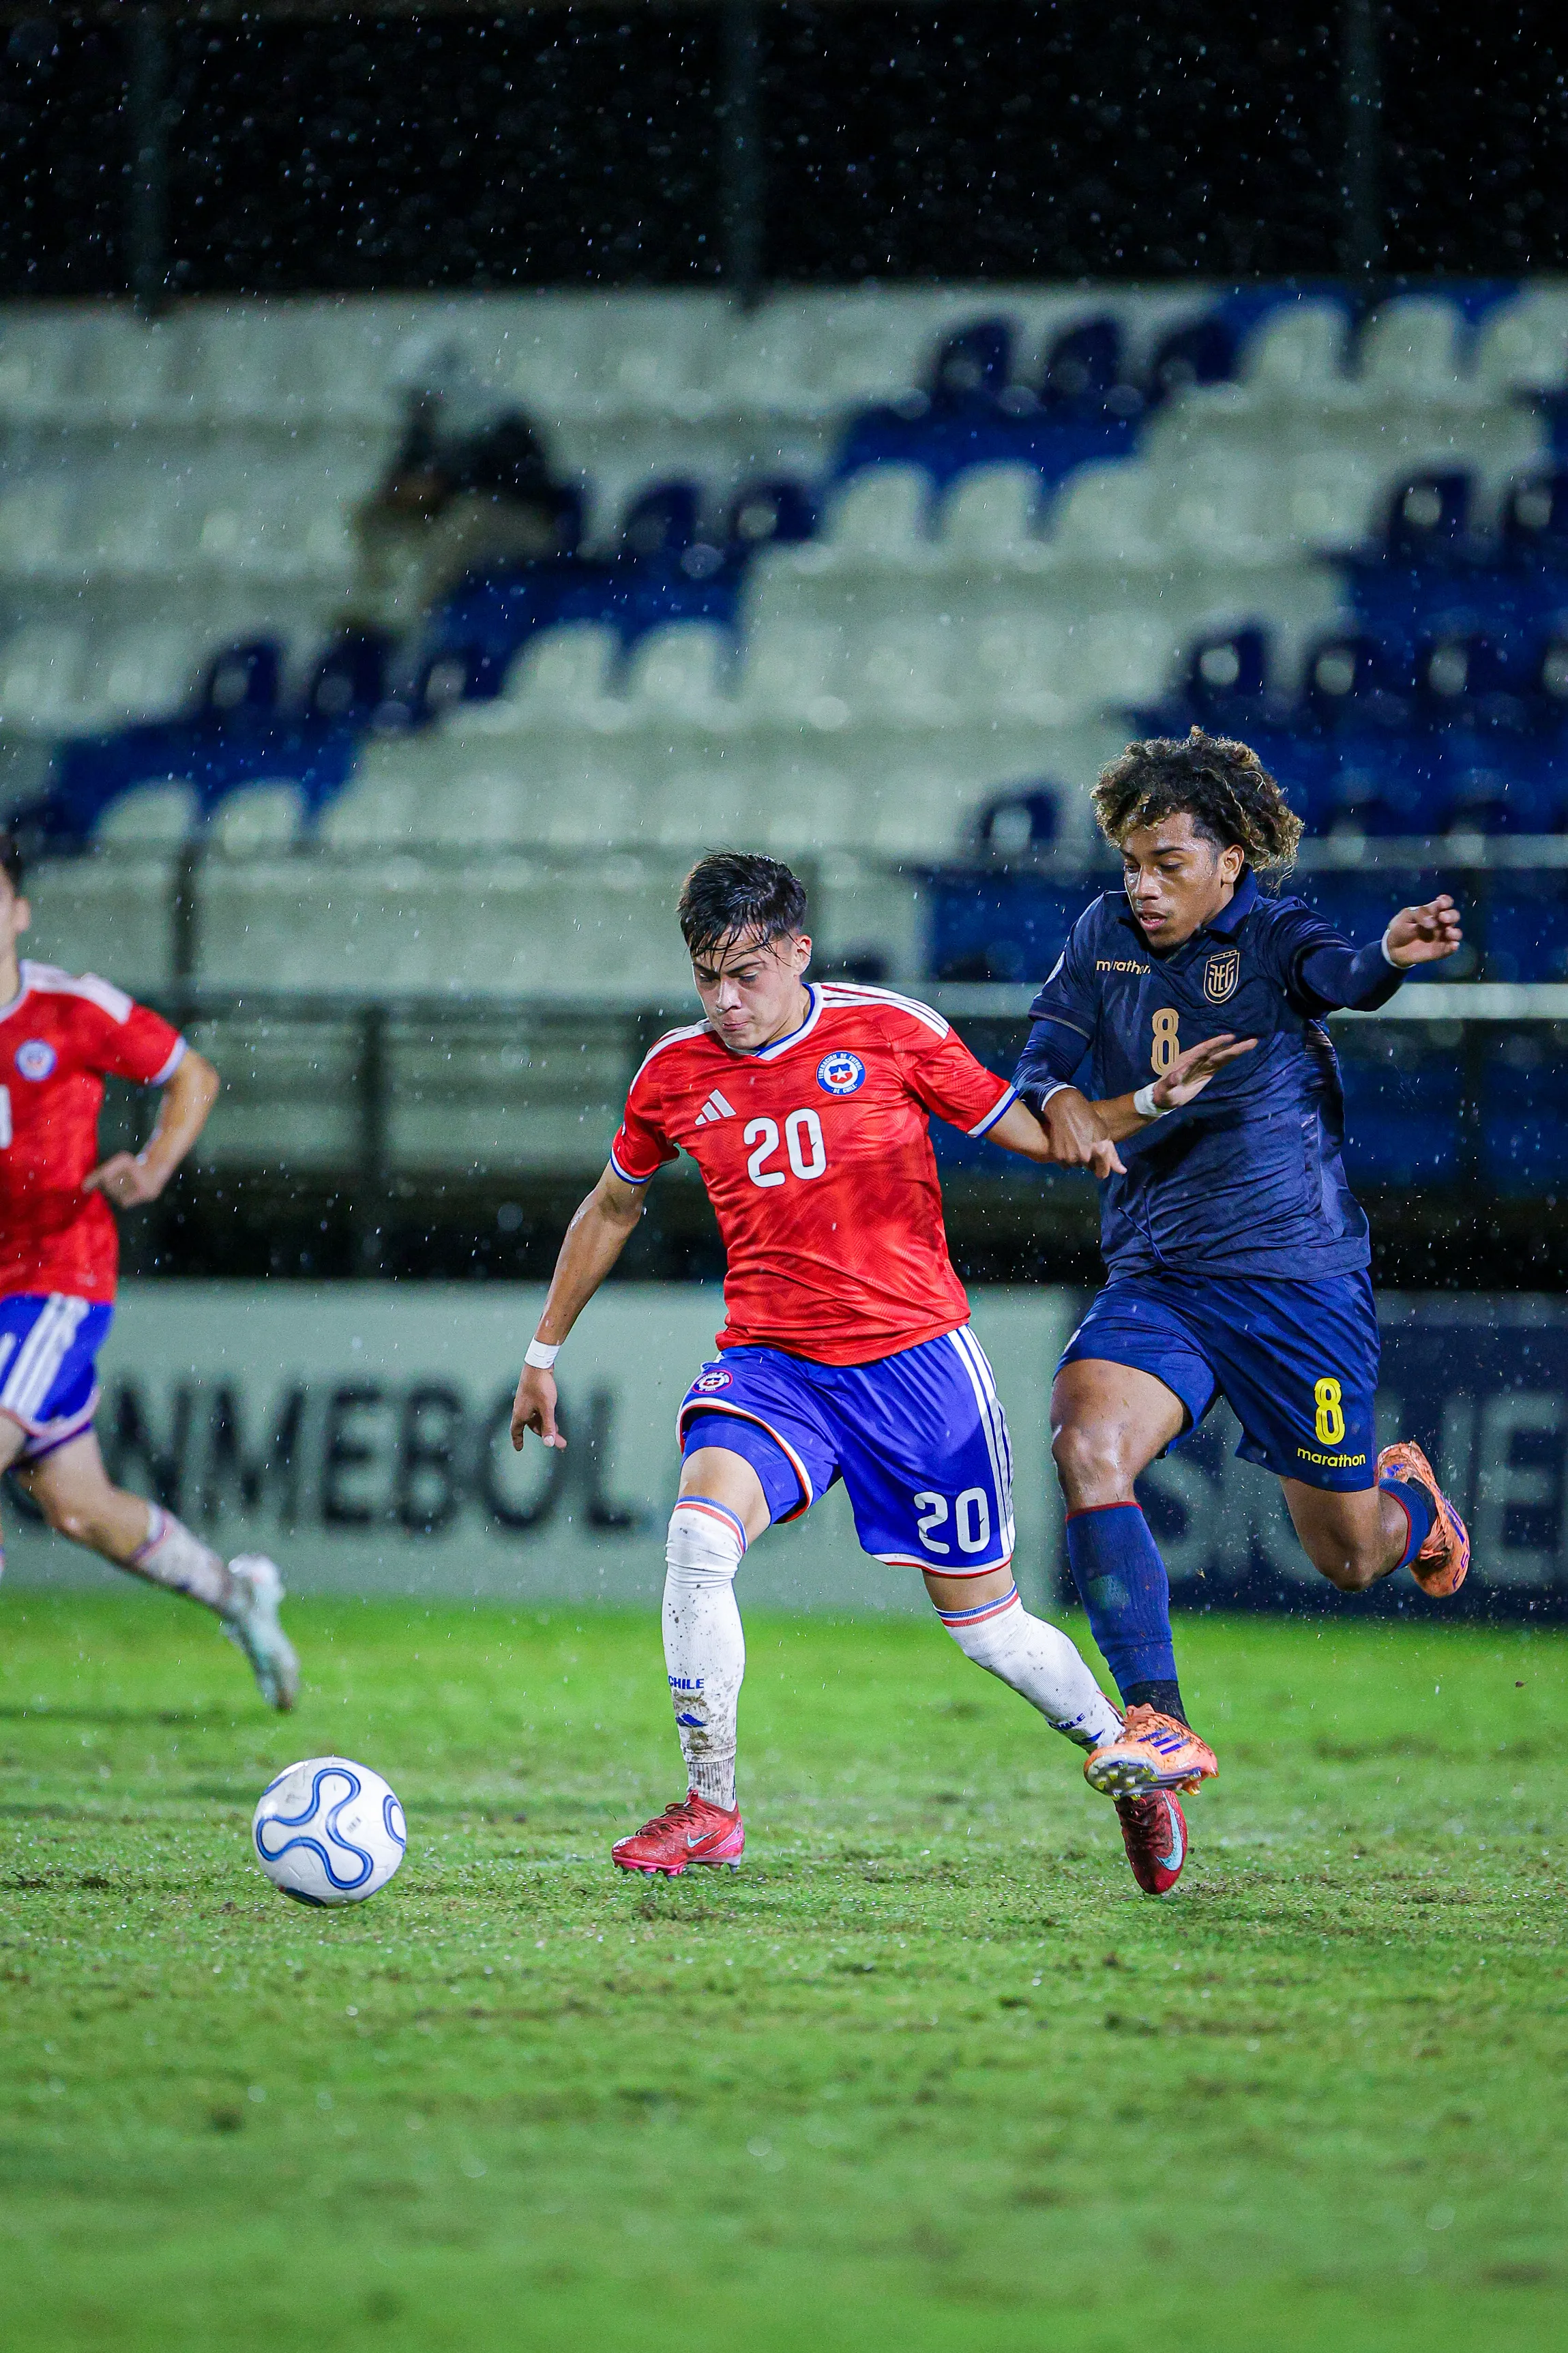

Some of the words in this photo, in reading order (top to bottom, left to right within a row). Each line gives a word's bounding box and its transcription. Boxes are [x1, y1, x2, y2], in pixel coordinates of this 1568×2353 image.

[1096, 960, 1151, 975] mrathon
[1151, 1008, 1180, 1076] 8
[743, 1108, 827, 1188] 20
[1314, 1377, 1345, 1445] 8
[1297, 1447, 1366, 1467] marathon
[914, 1487, 990, 1554] 20
[668, 1676, 705, 1689] CHILE
